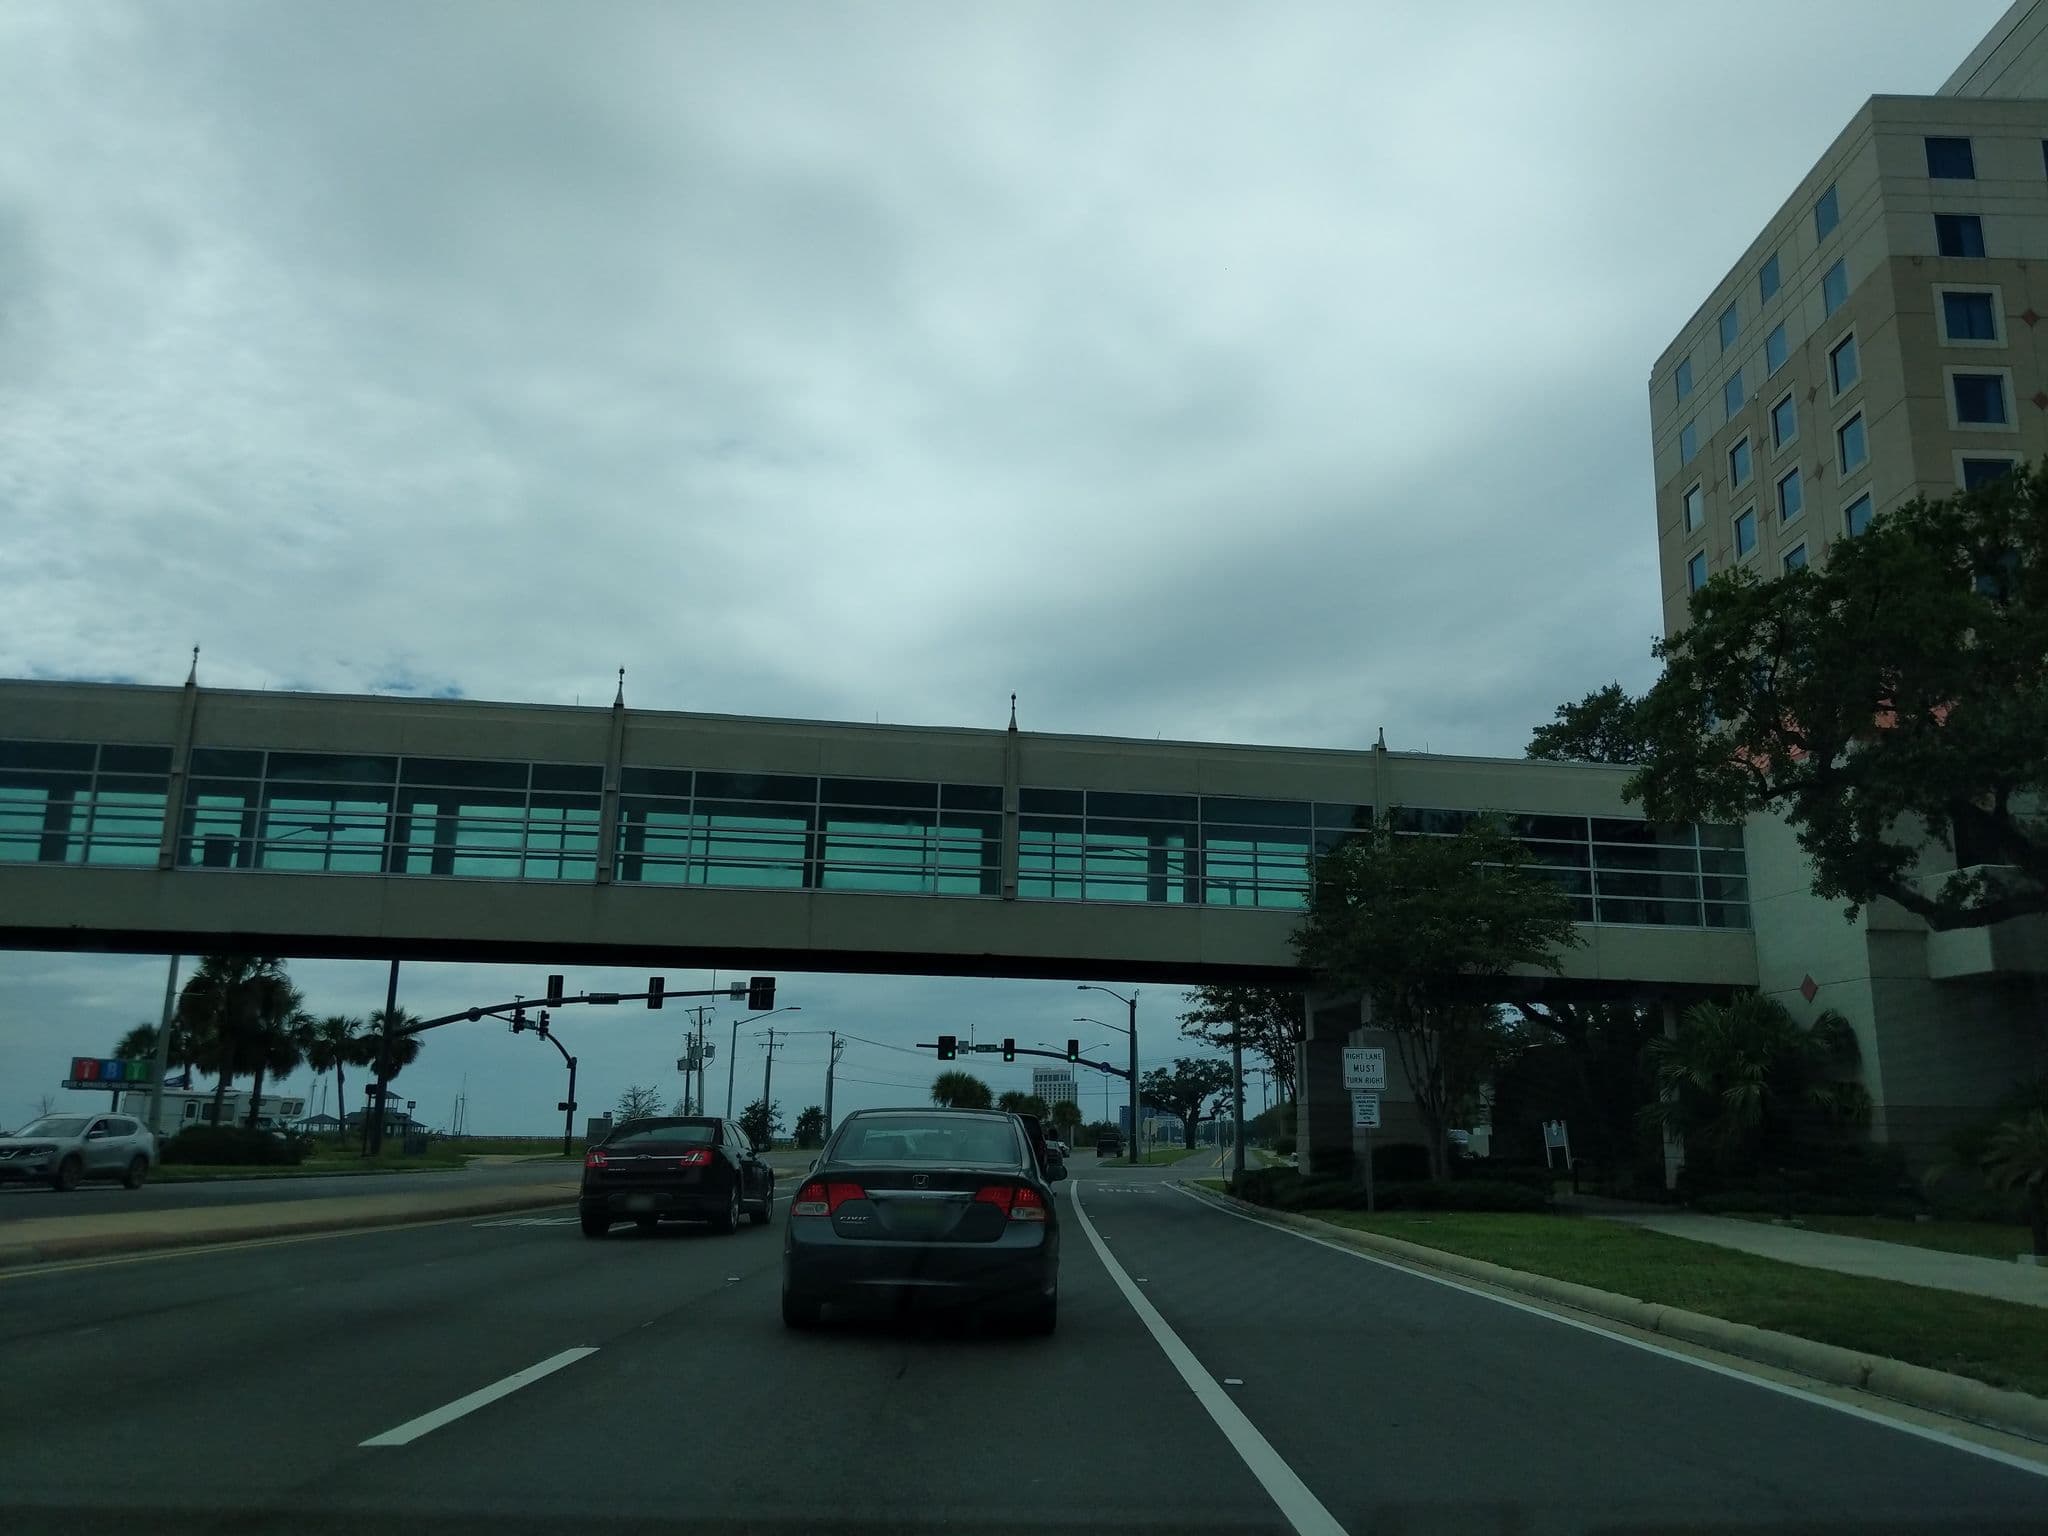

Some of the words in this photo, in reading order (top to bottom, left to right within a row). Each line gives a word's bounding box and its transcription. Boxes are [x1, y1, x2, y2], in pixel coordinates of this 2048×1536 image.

[1353, 1063, 1375, 1073] MUST
[1346, 1076, 1363, 1084] TURN
[1365, 1076, 1383, 1084] RIGHT
